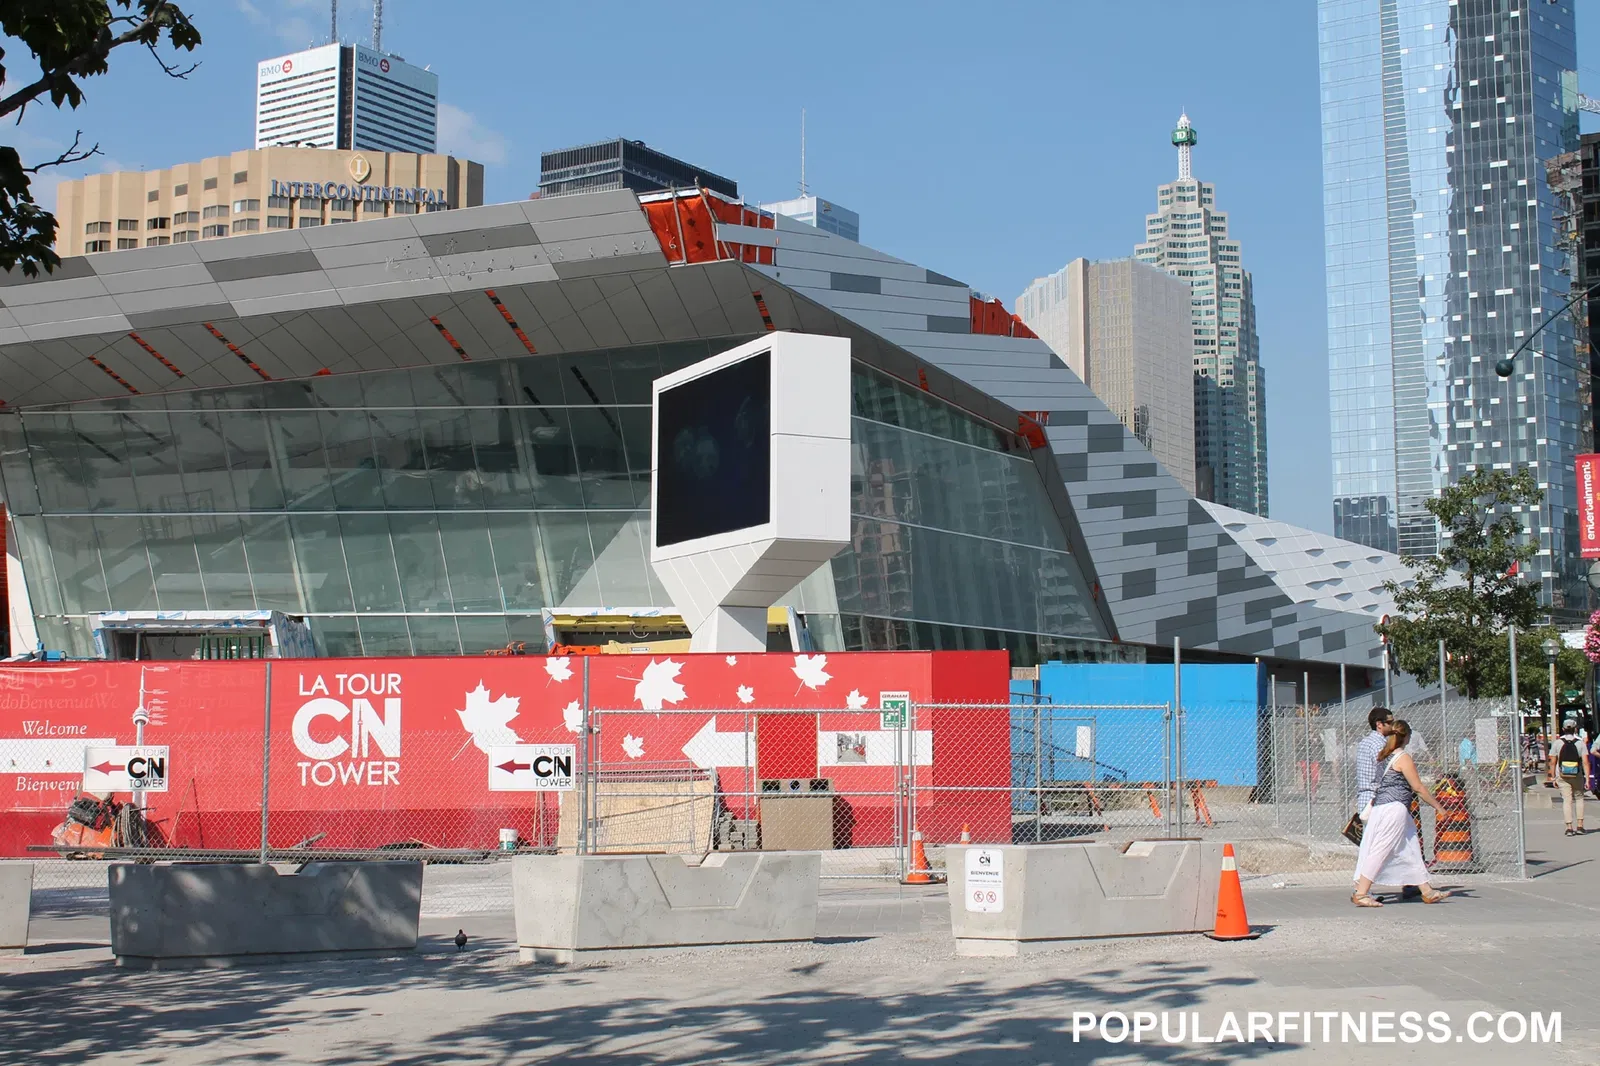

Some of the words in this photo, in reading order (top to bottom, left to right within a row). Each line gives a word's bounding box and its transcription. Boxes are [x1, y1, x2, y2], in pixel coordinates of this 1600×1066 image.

[358, 52, 379, 67] BMO
[260, 64, 281, 77] BMO
[299, 673, 329, 696] LA
[335, 673, 401, 695] TOUR
[22, 720, 87, 735] Welcome
[291, 697, 401, 760] CN
[127, 757, 164, 778] CN
[297, 761, 400, 786] TOWER
[533, 756, 571, 777] CN
[129, 779, 164, 788] TOWER
[535, 778, 571, 787] TOWER
[979, 856, 991, 864] CN
